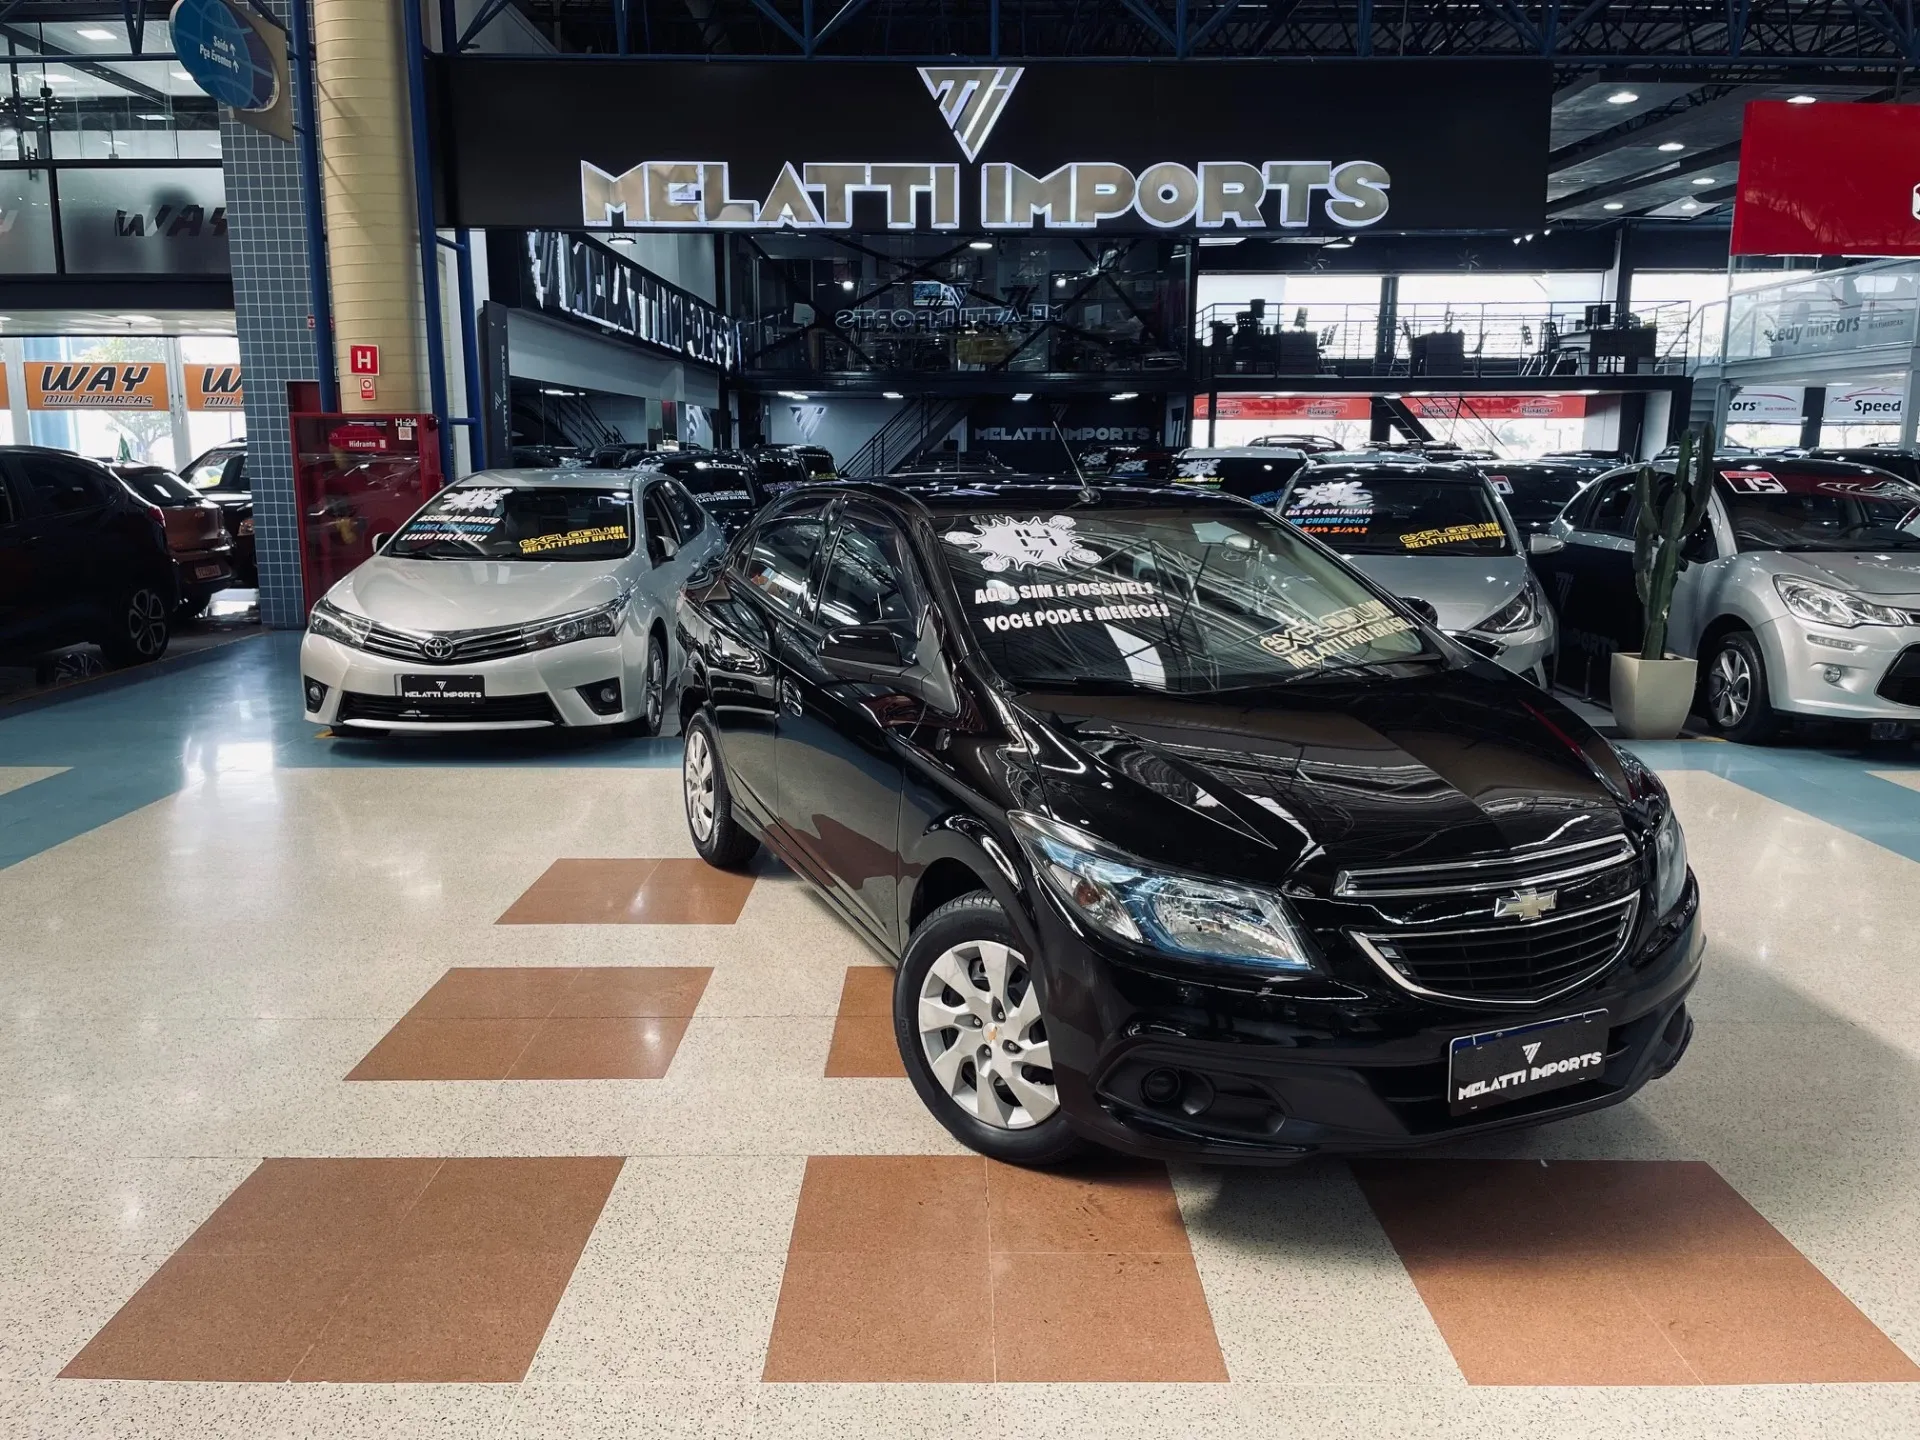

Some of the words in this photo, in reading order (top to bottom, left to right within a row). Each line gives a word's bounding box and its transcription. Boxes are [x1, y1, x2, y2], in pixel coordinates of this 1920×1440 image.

[581, 160, 960, 228] MELATTI
[981, 160, 1391, 228] IMPORTS
[357, 350, 371, 369] H
[41, 365, 151, 393] WAY
[43, 394, 153, 406] MULTIMARCAS
[349, 440, 376, 448] Hidrante
[974, 427, 1055, 441] MELATTI
[1063, 427, 1150, 441] IMPORTS
[1305, 517, 1344, 525] CHARME
[1339, 508, 1373, 516] FALTAVA
[522, 540, 567, 554] MELATTI
[568, 537, 590, 547] PRO
[592, 532, 629, 542] BRASIL
[1014, 528, 1058, 547] 14
[1405, 536, 1448, 550] MELATTI
[1448, 533, 1470, 542] PRO
[1472, 529, 1507, 539] BRASIL
[975, 585, 1017, 604] AQUI
[1018, 584, 1054, 599] SIM
[1034, 607, 1082, 627] PODE
[1083, 609, 1093, 621] E
[1094, 603, 1170, 621] MERECE!
[1285, 638, 1349, 670] MELATTI
[1344, 628, 1373, 647] PRO
[1369, 616, 1416, 638] BRASIL
[1458, 1069, 1527, 1100] MELATTI
[1529, 1051, 1602, 1081] IMPORTS
